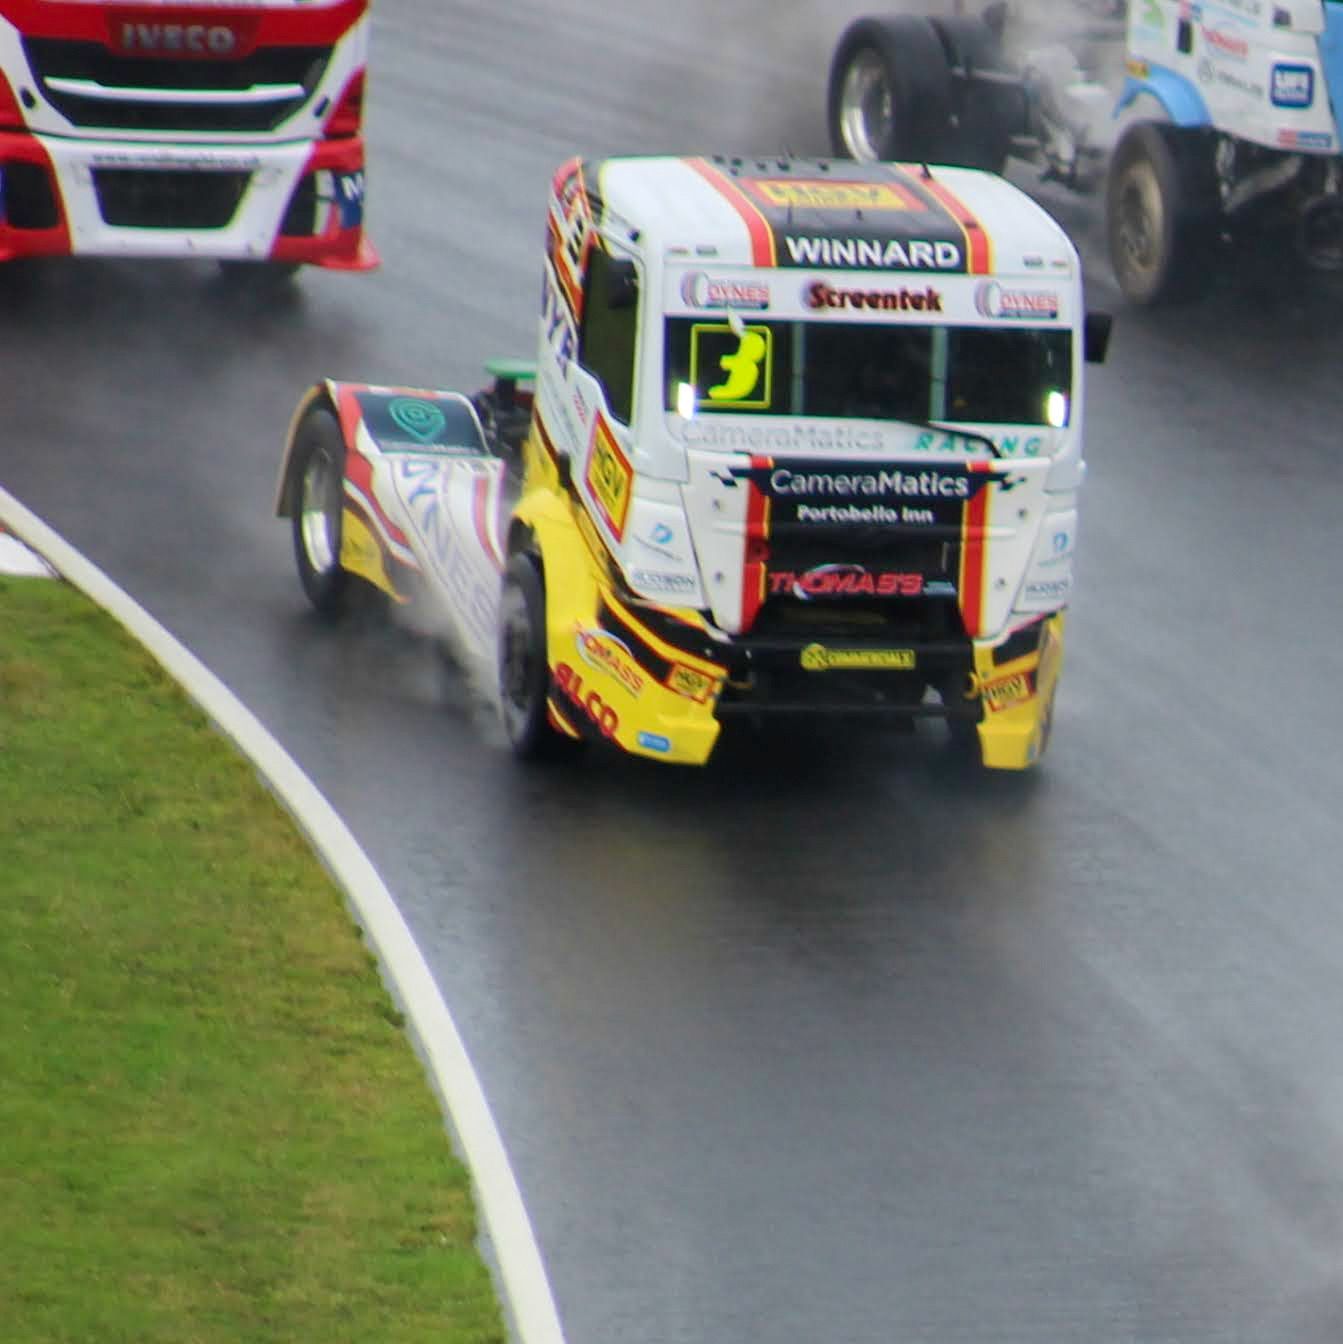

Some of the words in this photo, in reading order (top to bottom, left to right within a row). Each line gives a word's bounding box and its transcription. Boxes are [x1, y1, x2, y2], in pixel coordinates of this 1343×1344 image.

[120, 23, 235, 50] IVECO
[786, 236, 960, 268] WINNARD
[808, 282, 943, 314] Screentek
[709, 330, 766, 400] 3
[770, 469, 970, 497] CameraMatics
[796, 505, 897, 524] Portobello
[902, 505, 934, 524] Inn
